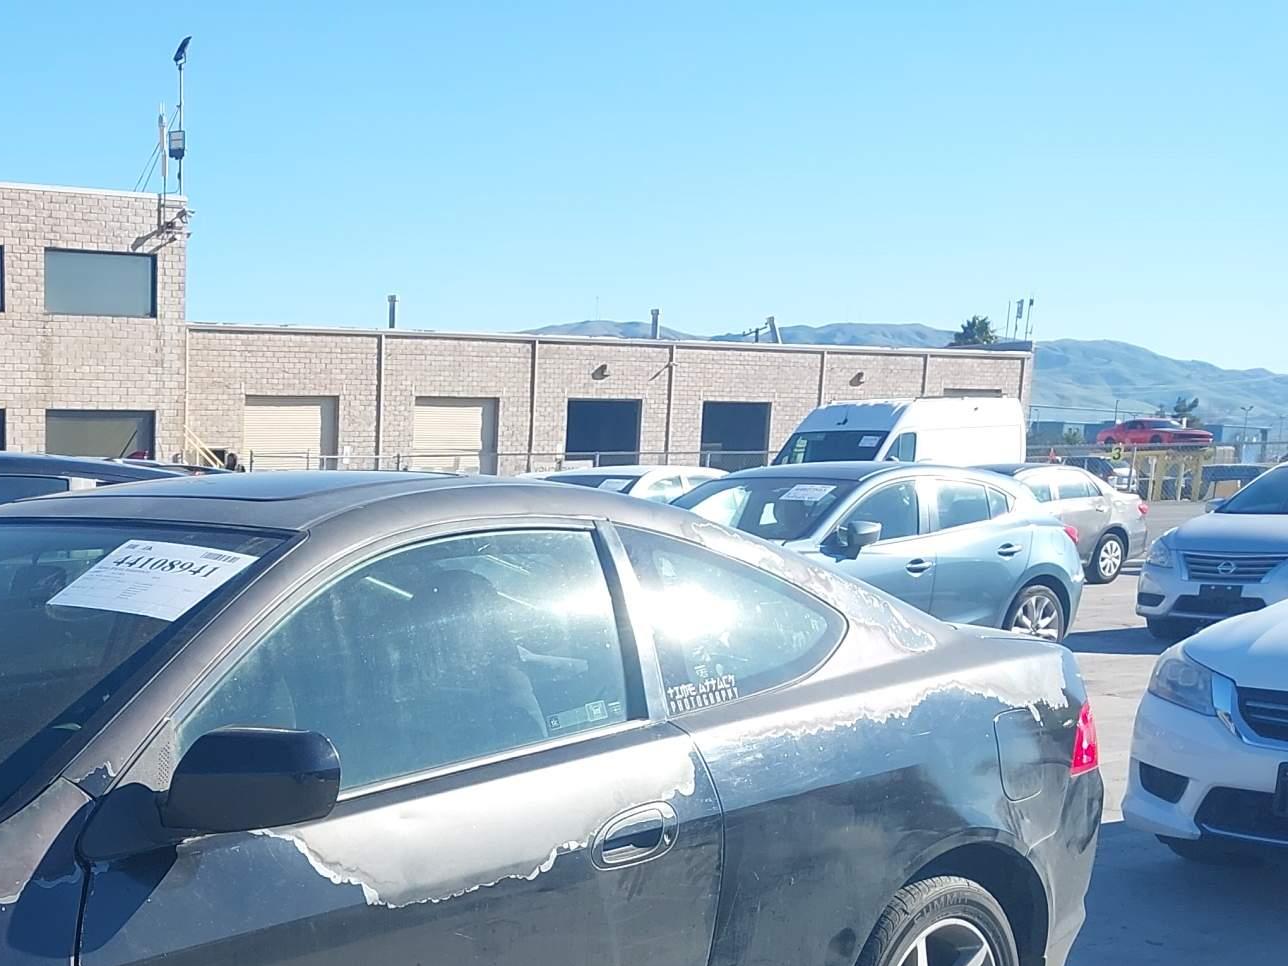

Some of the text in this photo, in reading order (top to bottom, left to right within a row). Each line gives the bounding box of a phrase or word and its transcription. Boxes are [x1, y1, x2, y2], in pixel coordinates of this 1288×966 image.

[1112, 447, 1121, 460] 3
[113, 555, 219, 578] 44108941
[670, 687, 739, 713] PHOTOGRAPHY
